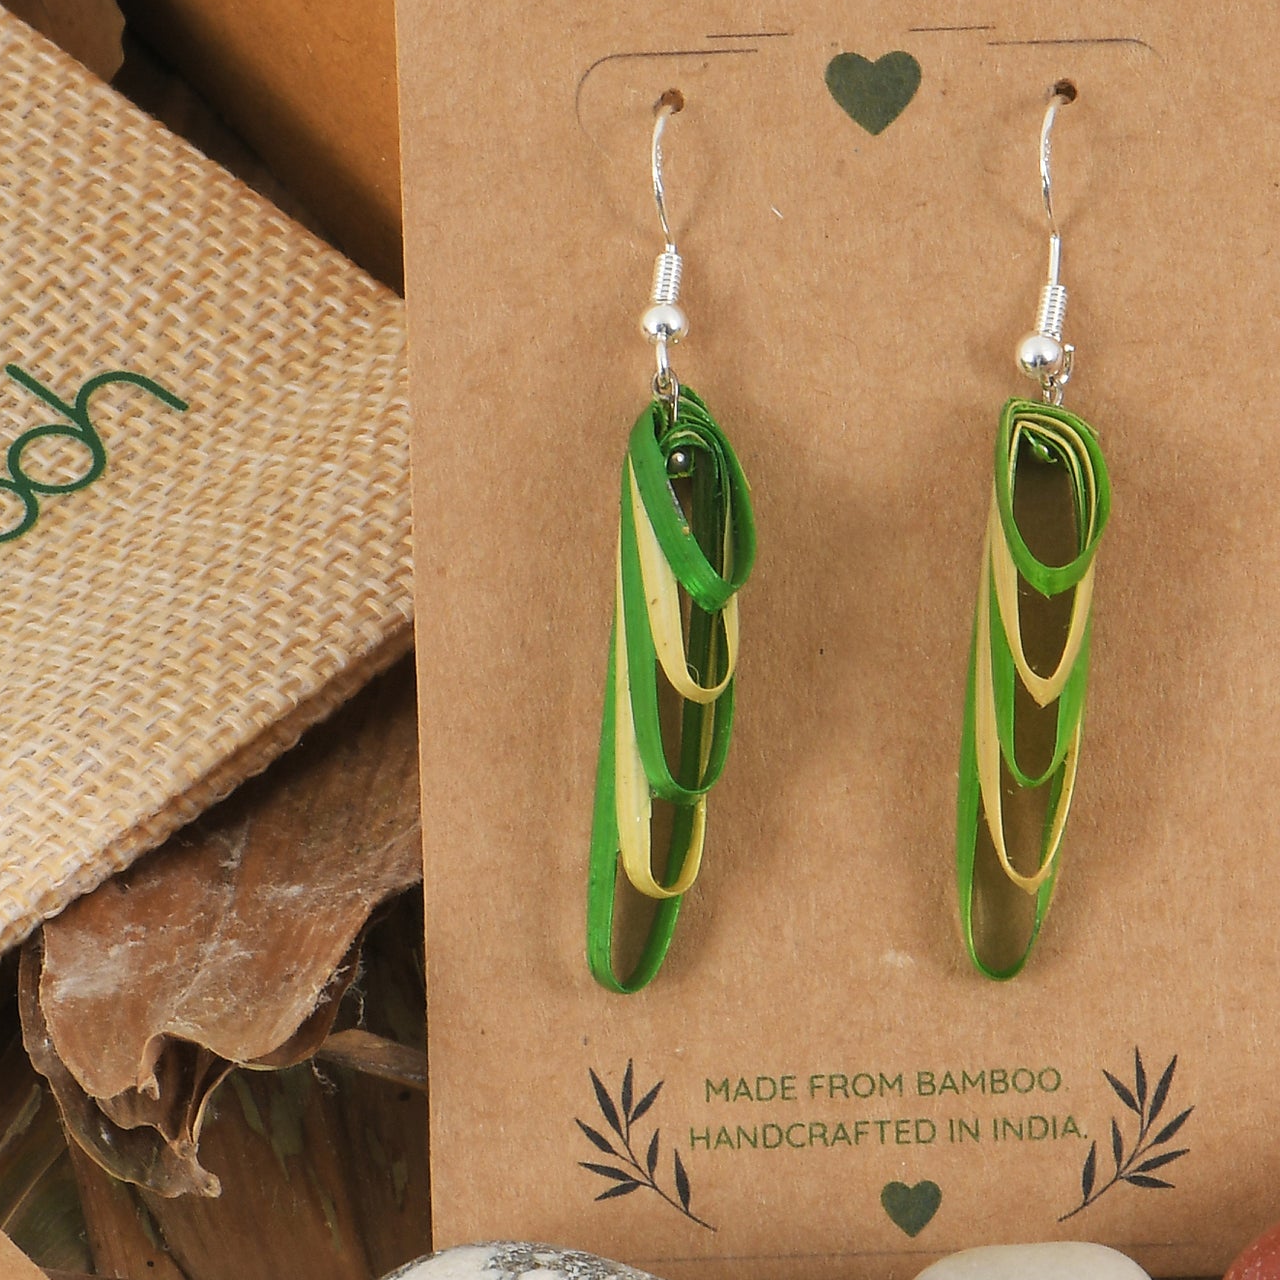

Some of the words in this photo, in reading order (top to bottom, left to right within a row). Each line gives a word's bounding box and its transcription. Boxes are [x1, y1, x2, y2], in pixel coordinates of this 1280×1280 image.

[704, 1075, 797, 1103] MADE
[809, 1072, 904, 1099] FROM
[689, 1118, 936, 1150] HANDCRAFTED
[949, 1119, 981, 1144] IN
[992, 1114, 1089, 1141] INDIA.
